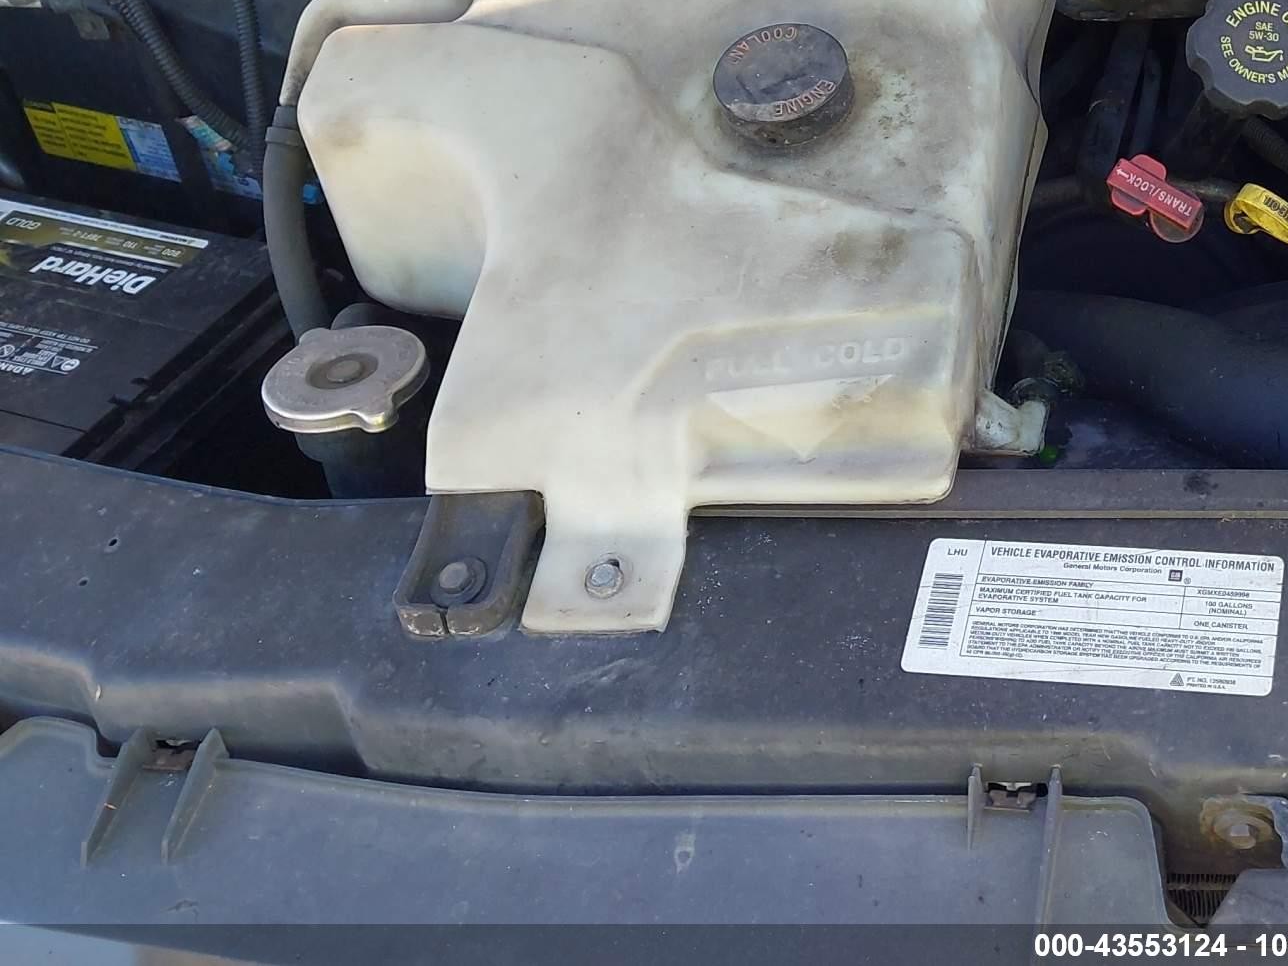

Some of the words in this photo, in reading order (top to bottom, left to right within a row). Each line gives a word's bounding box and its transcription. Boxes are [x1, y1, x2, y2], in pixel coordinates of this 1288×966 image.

[1225, 0, 1282, 28] ENGINE
[1256, 22, 1273, 32] SAE
[1248, 31, 1280, 42] 5W-30
[726, 26, 798, 66] COOLANT
[1220, 35, 1234, 60] SEE
[1228, 58, 1276, 84] OWNER'S
[773, 79, 837, 118] ENGINE
[1128, 174, 1195, 218] TRANS/LOCK
[6, 217, 42, 230] GOLD
[29, 256, 156, 294] DieHard
[705, 350, 791, 380] FULL
[816, 337, 905, 368] COLD
[947, 547, 968, 557] LHU
[991, 546, 1032, 558] VEHICLE
[1034, 548, 1100, 562] EVAPORATIVE
[1103, 552, 1152, 565] EMISSION
[1155, 556, 1202, 568] CONTROL
[1204, 559, 1275, 572] INFORMATION
[1063, 562, 1091, 570] General
[1119, 566, 1162, 576] Corporation
[982, 576, 1031, 585] EVAPORATIVE
[1032, 578, 1068, 587] EMISSION
[978, 593, 1028, 602] EVAPORATIVE
[979, 586, 1014, 594] MAXIMUM
[1016, 588, 1052, 597] CERTIFIED
[1094, 594, 1130, 602] CAPACITY
[976, 606, 1000, 614] VAPOR
[1002, 608, 1036, 616] STORAGE
[1208, 608, 1247, 616] (NOMINAL)
[1218, 602, 1253, 610] GALLONS
[1211, 621, 1248, 630] CANISTER
